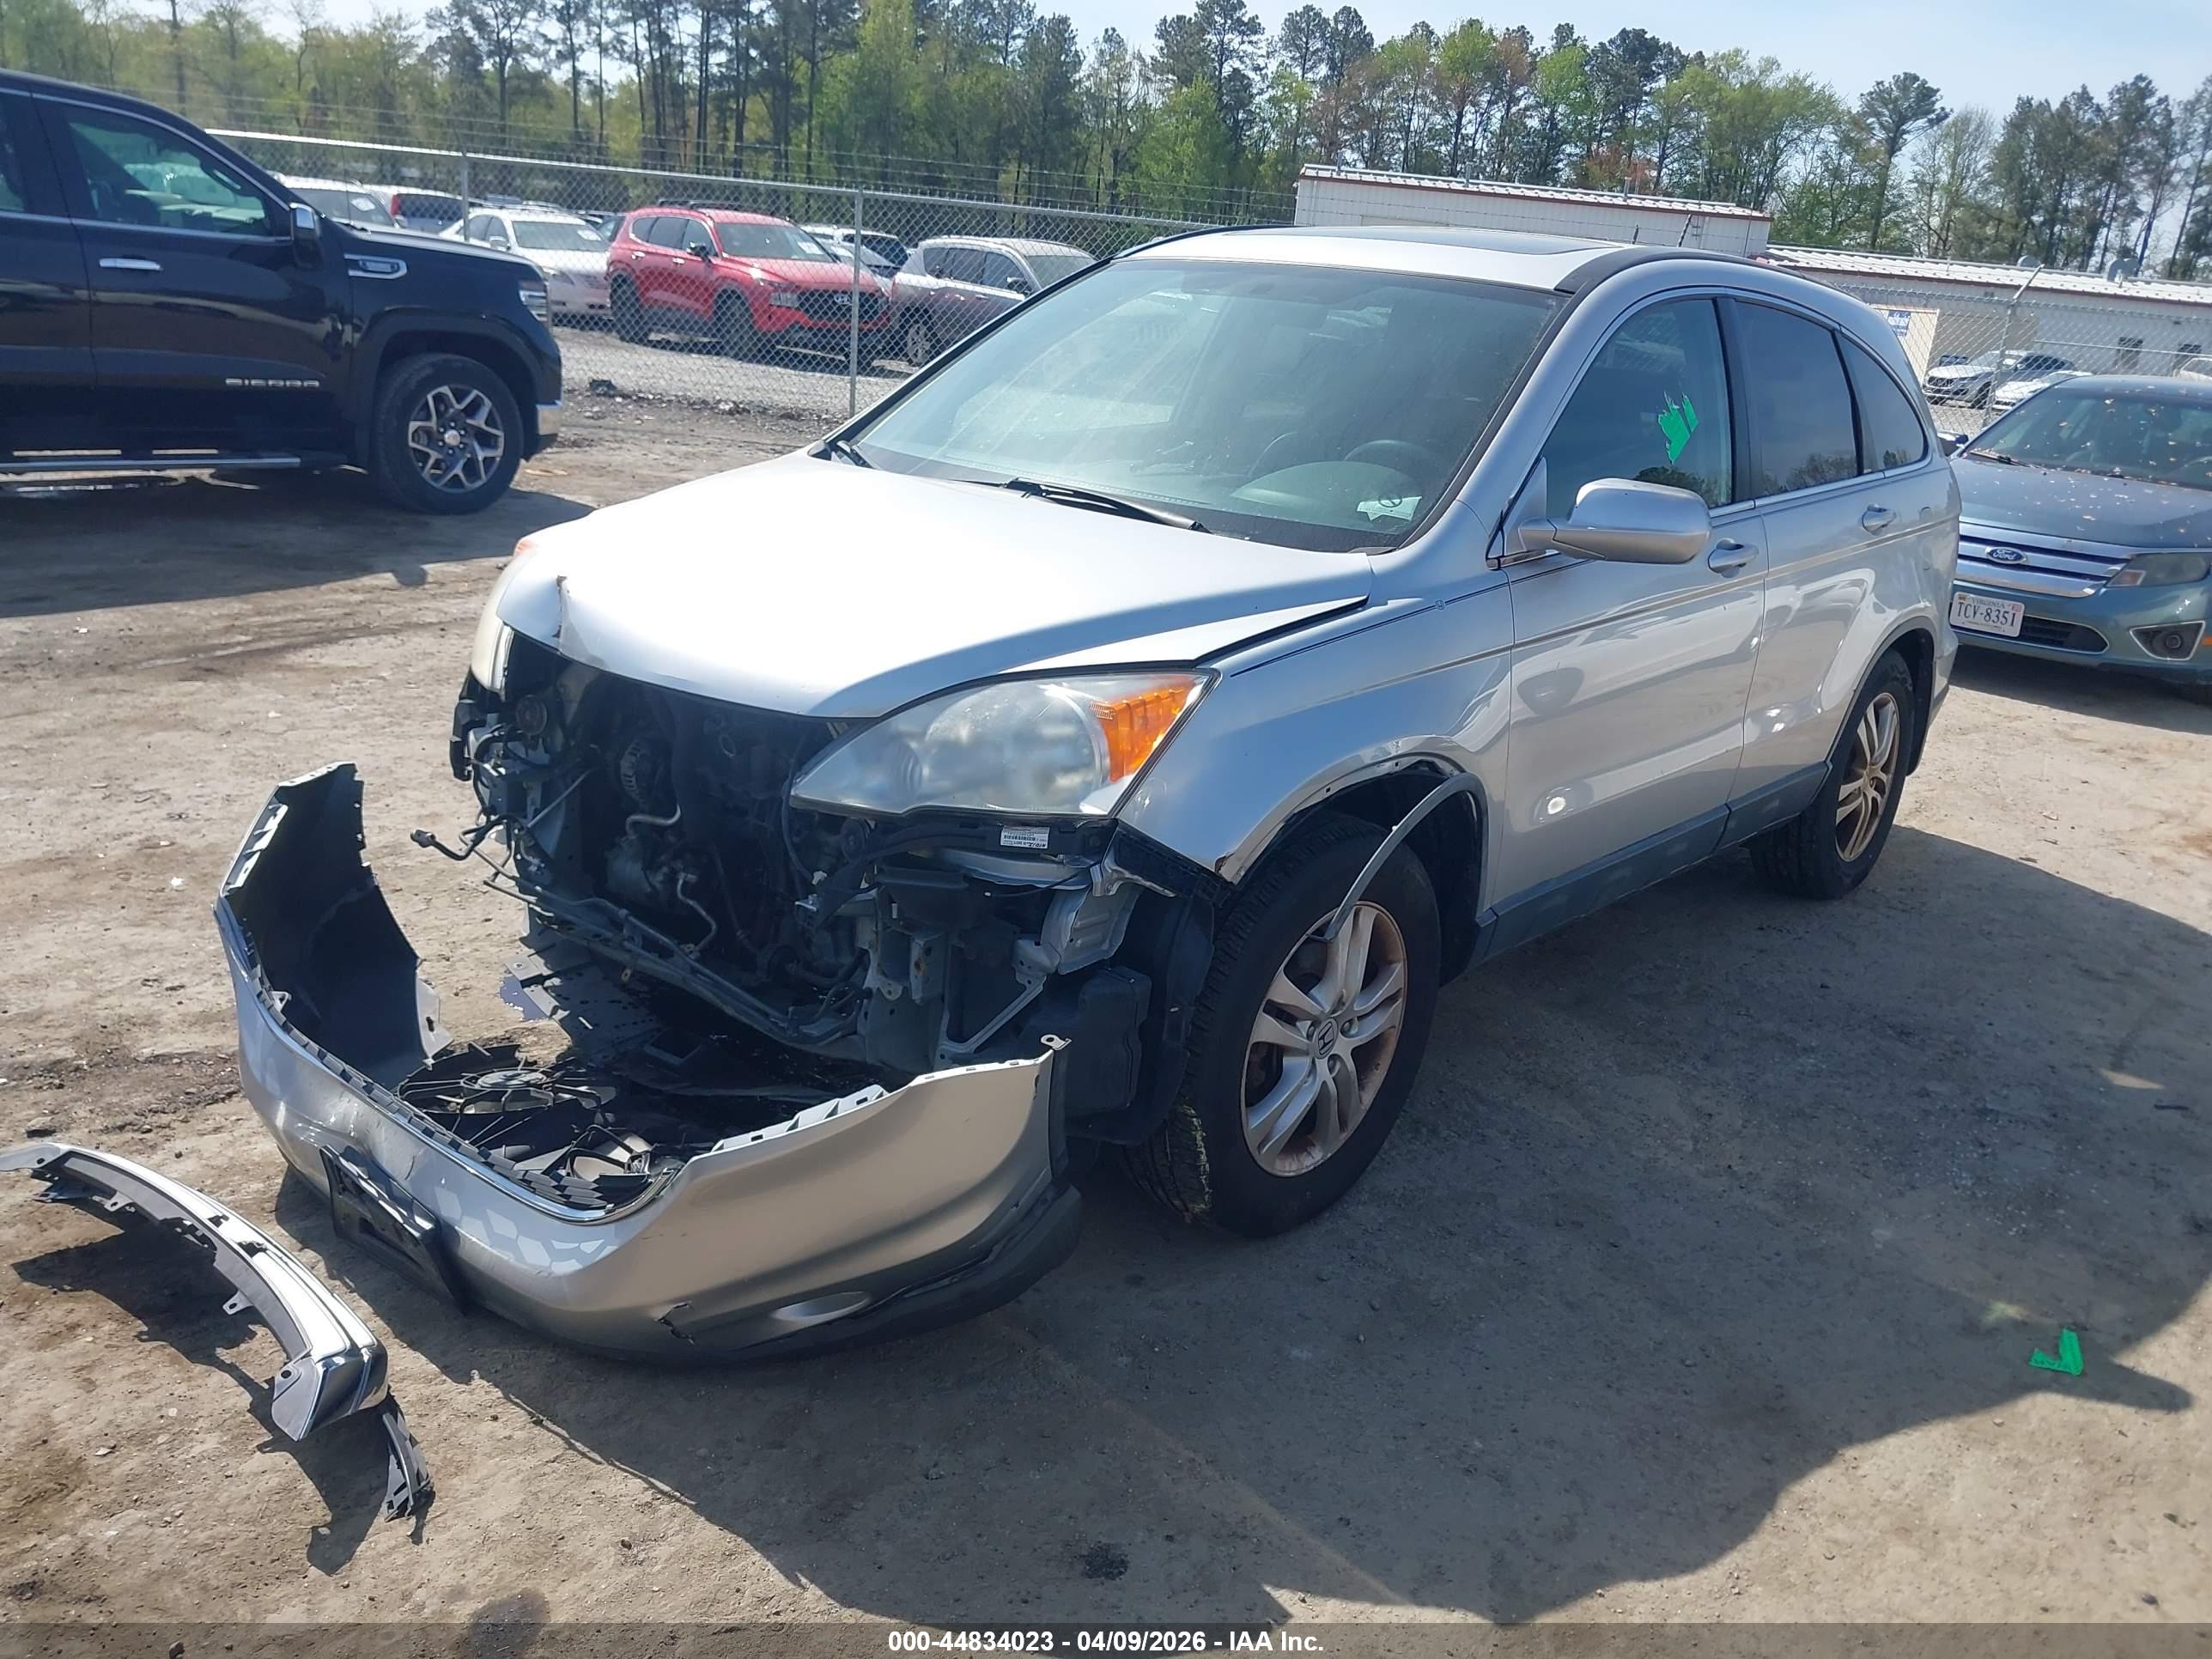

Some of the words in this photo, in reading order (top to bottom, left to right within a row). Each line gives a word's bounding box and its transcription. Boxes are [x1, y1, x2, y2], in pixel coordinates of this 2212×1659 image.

[225, 378, 320, 388] SIERRA
[1992, 549, 2018, 560] Ford
[1957, 602, 2016, 627] TCV-8351
